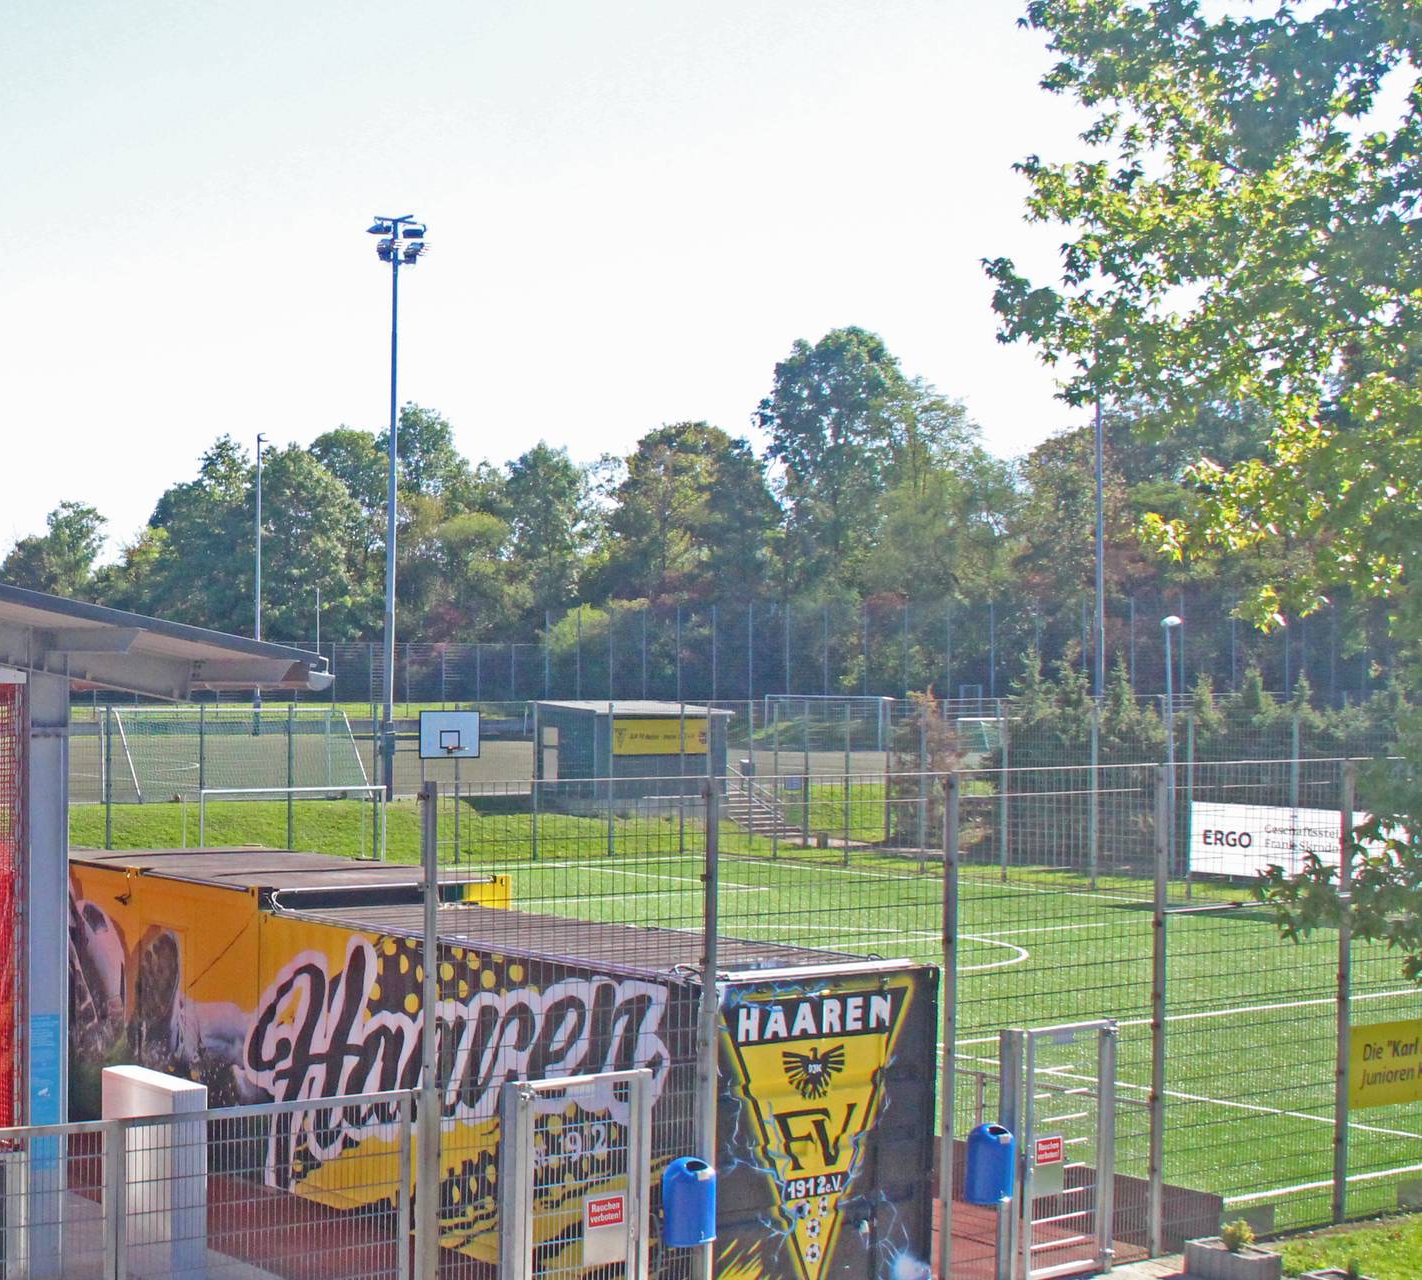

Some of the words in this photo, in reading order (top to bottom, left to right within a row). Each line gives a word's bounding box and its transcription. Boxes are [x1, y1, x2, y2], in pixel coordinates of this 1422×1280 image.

[1203, 829, 1252, 848] ERGO
[737, 994, 892, 1043] HAAREN
[245, 937, 668, 1180] Haaren
[1362, 1042, 1384, 1062] Die
[1359, 1065, 1415, 1090] Junioren
[773, 1102, 858, 1172] FV
[787, 1175, 826, 1199] 1912
[590, 1210, 621, 1223] verboten!
[592, 1201, 620, 1213] Rauchen
